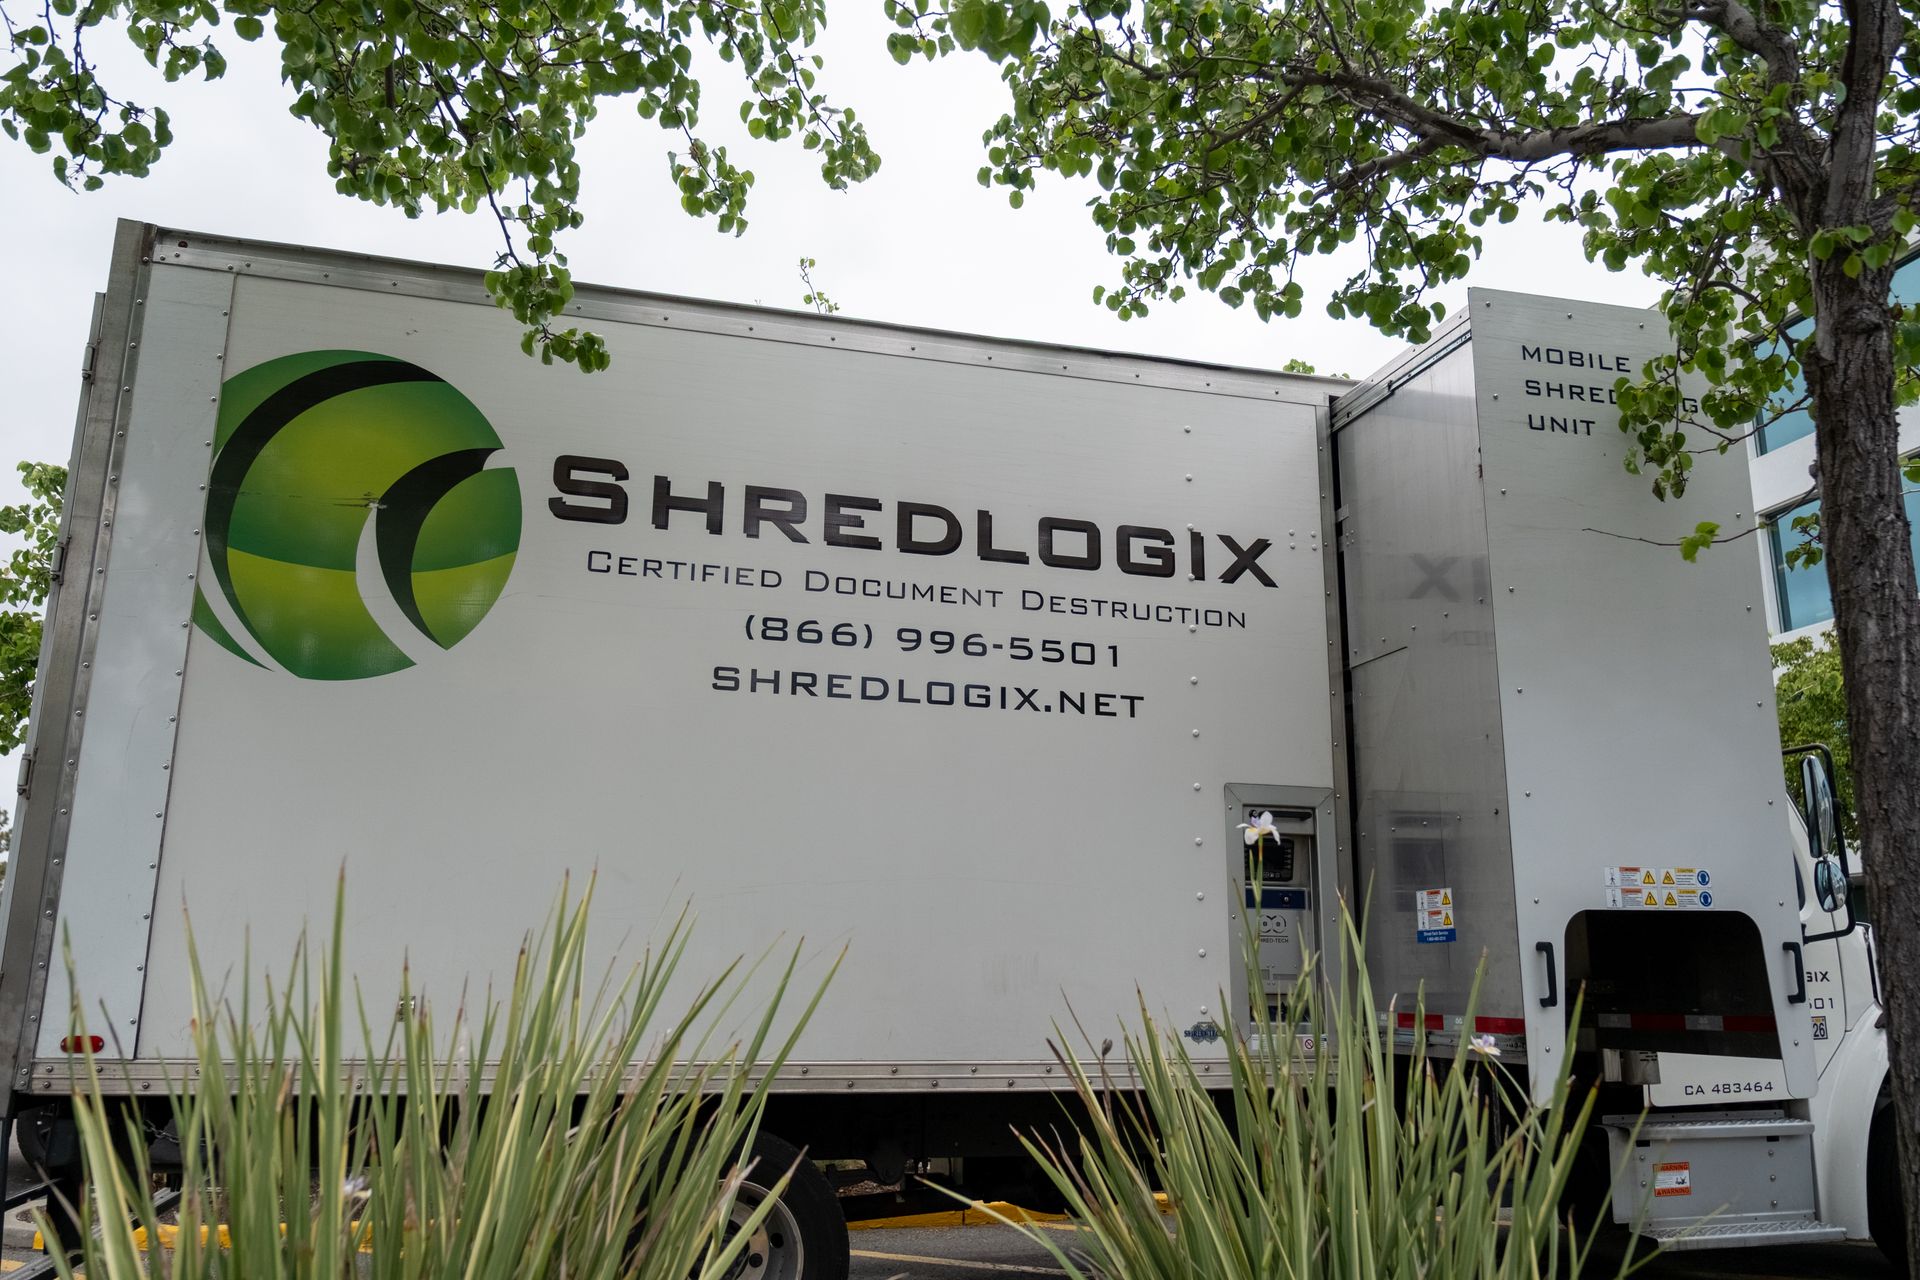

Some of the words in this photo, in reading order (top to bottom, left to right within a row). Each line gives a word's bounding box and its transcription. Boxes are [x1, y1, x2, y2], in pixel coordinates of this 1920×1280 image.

[1521, 344, 1632, 373] MOBILE
[1525, 379, 1699, 414] SHREG
[1527, 413, 1596, 437] UNIT
[547, 454, 1280, 589] SHREDLOGIX
[587, 550, 783, 589] CERTIFIED
[804, 569, 1004, 608] DOCUMENT
[1021, 589, 1246, 629] DESTRUCTION
[744, 614, 873, 649] (866)
[896, 627, 1118, 668] 996-5501
[711, 666, 1145, 719] SHREDLOGIX.NET
[1812, 1022, 1826, 1038] 26
[1684, 1084, 1706, 1096] CA
[1711, 1081, 1774, 1095] 483464
[1662, 1187, 1689, 1196] WARNING
